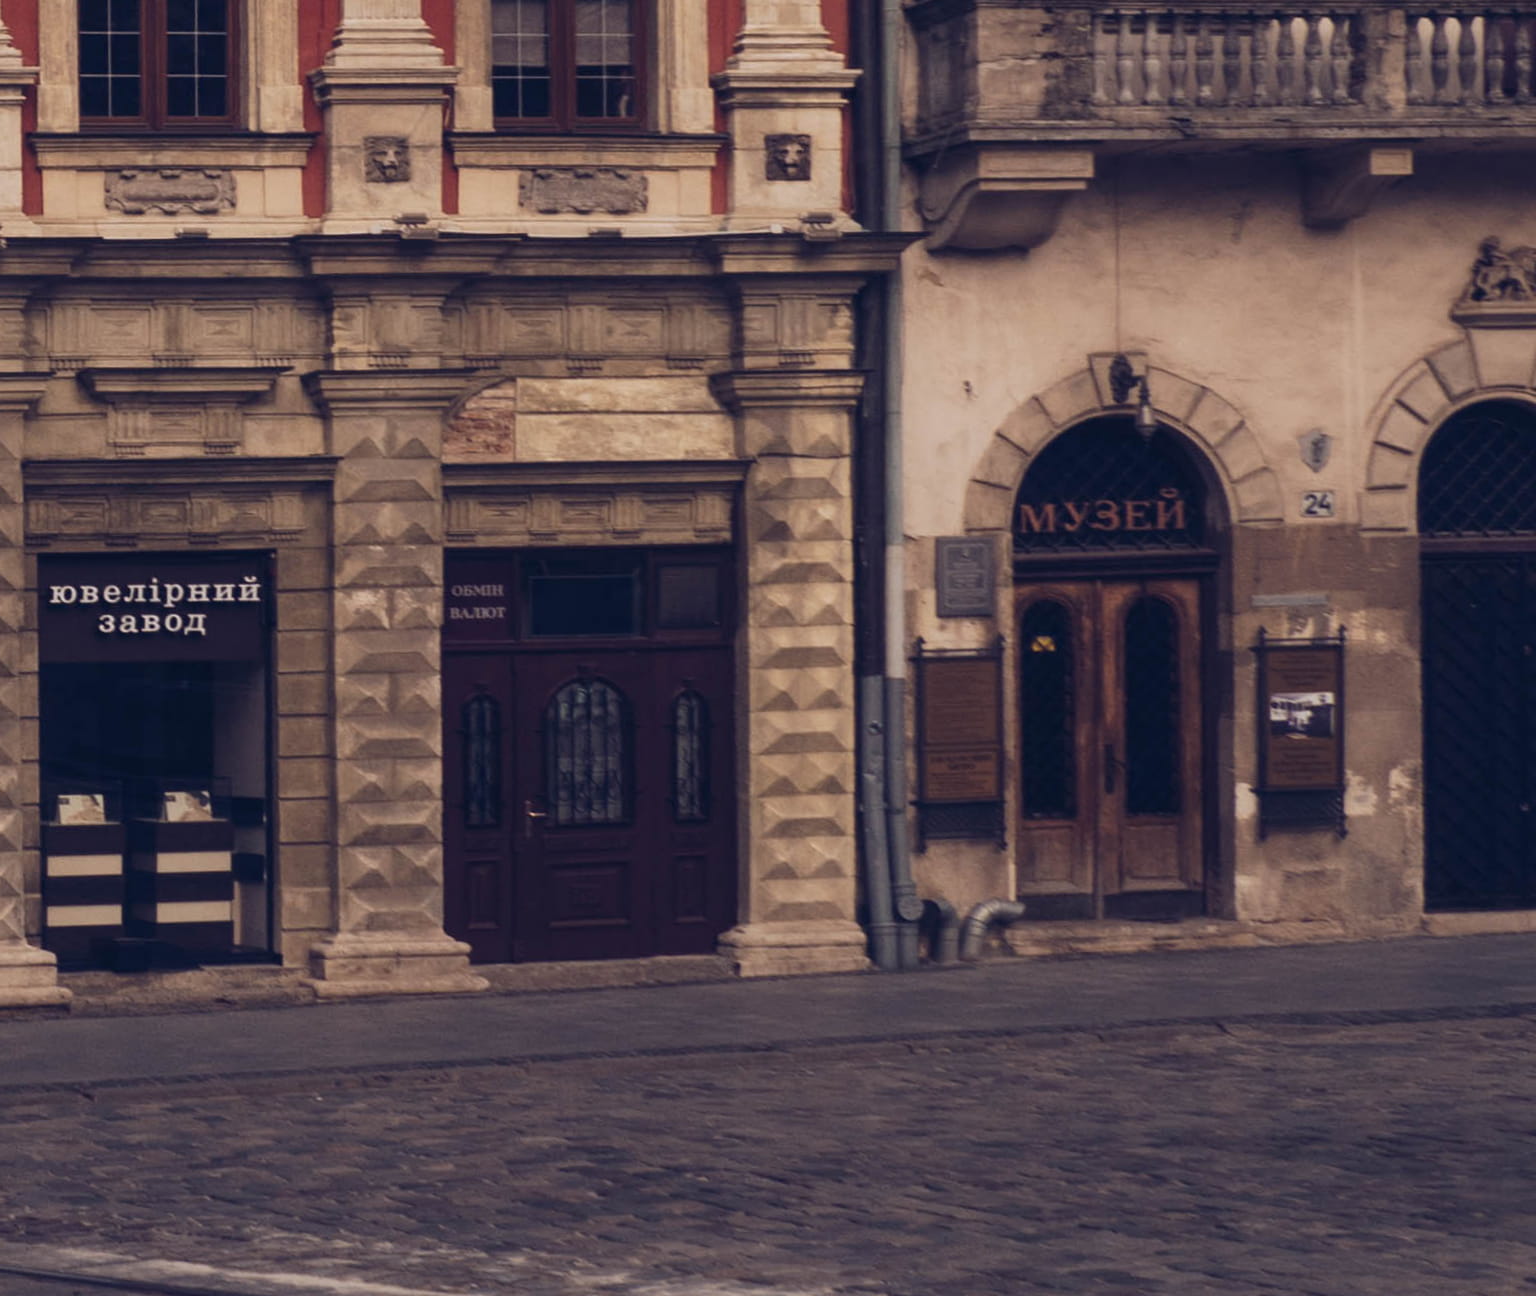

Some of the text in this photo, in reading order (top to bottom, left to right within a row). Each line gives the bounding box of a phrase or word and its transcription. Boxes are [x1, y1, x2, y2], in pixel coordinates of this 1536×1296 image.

[1018, 487, 1188, 535] МУЗЕЙ
[1304, 493, 1331, 515] 24
[48, 576, 262, 608] ювелірний
[451, 584, 505, 598] ОБМІН
[449, 606, 507, 620] ВАЛЮТ
[97, 613, 208, 637] завод
